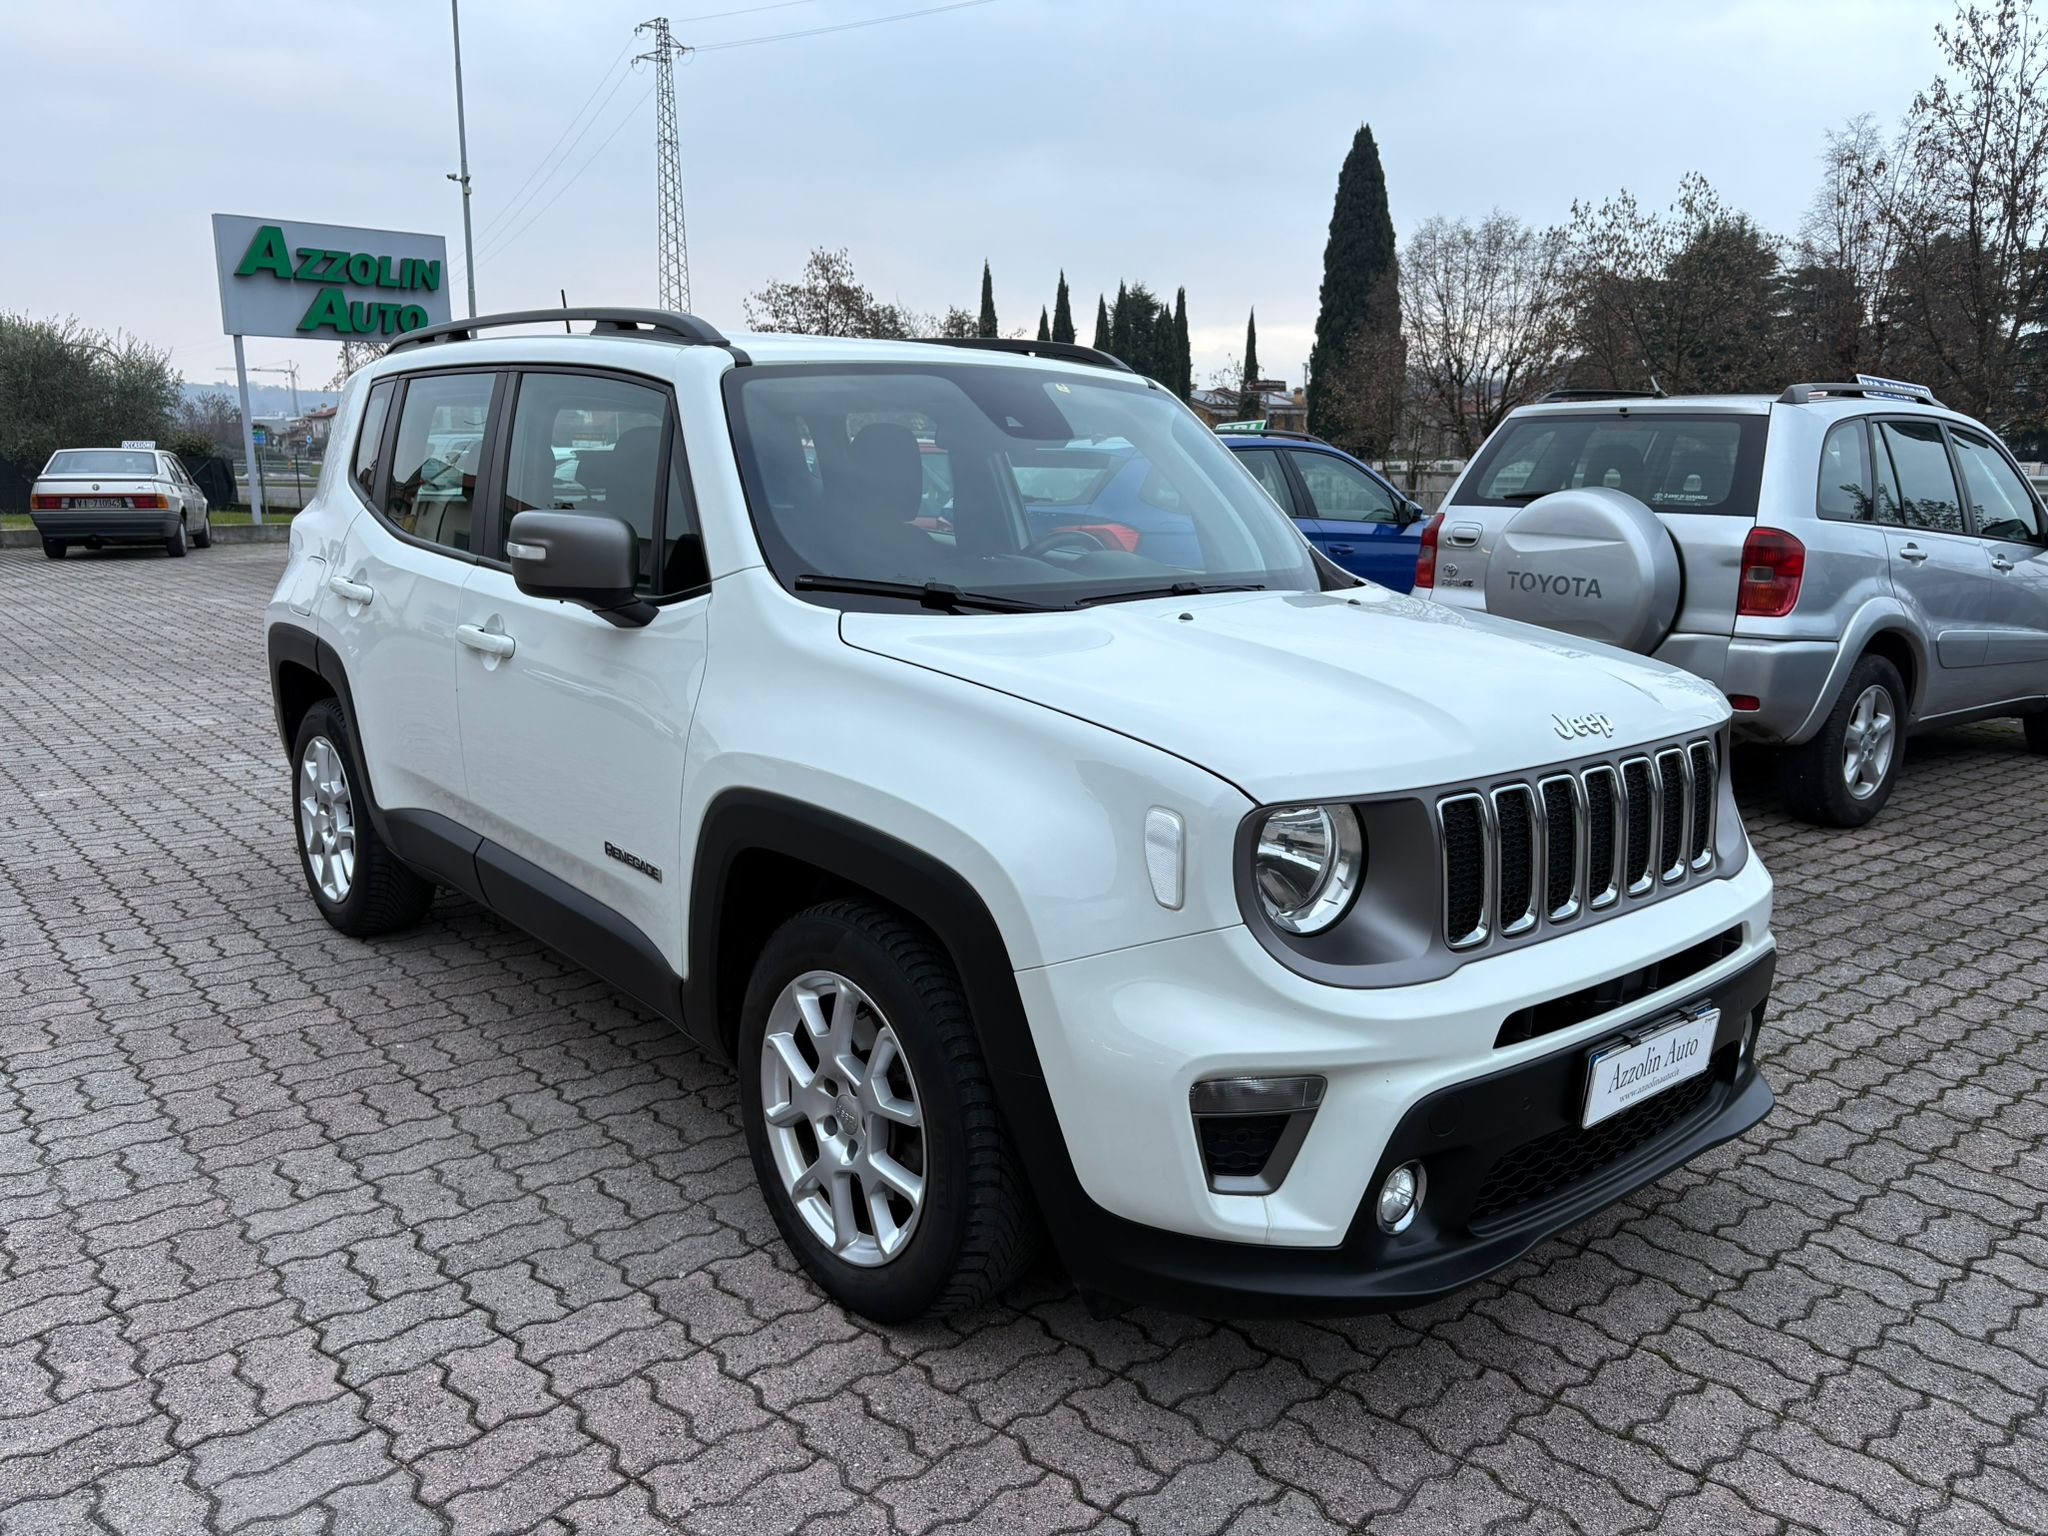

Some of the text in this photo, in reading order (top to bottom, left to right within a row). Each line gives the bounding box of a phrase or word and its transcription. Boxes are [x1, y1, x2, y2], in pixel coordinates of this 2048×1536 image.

[234, 225, 441, 291] AZZOLIN
[296, 287, 428, 334] AUTO
[1507, 571, 1602, 599] TOYOTA
[1551, 712, 1614, 741] Jeep
[604, 840, 663, 884] RENEGADE
[1607, 1037, 1699, 1095] Azzolin Auto
